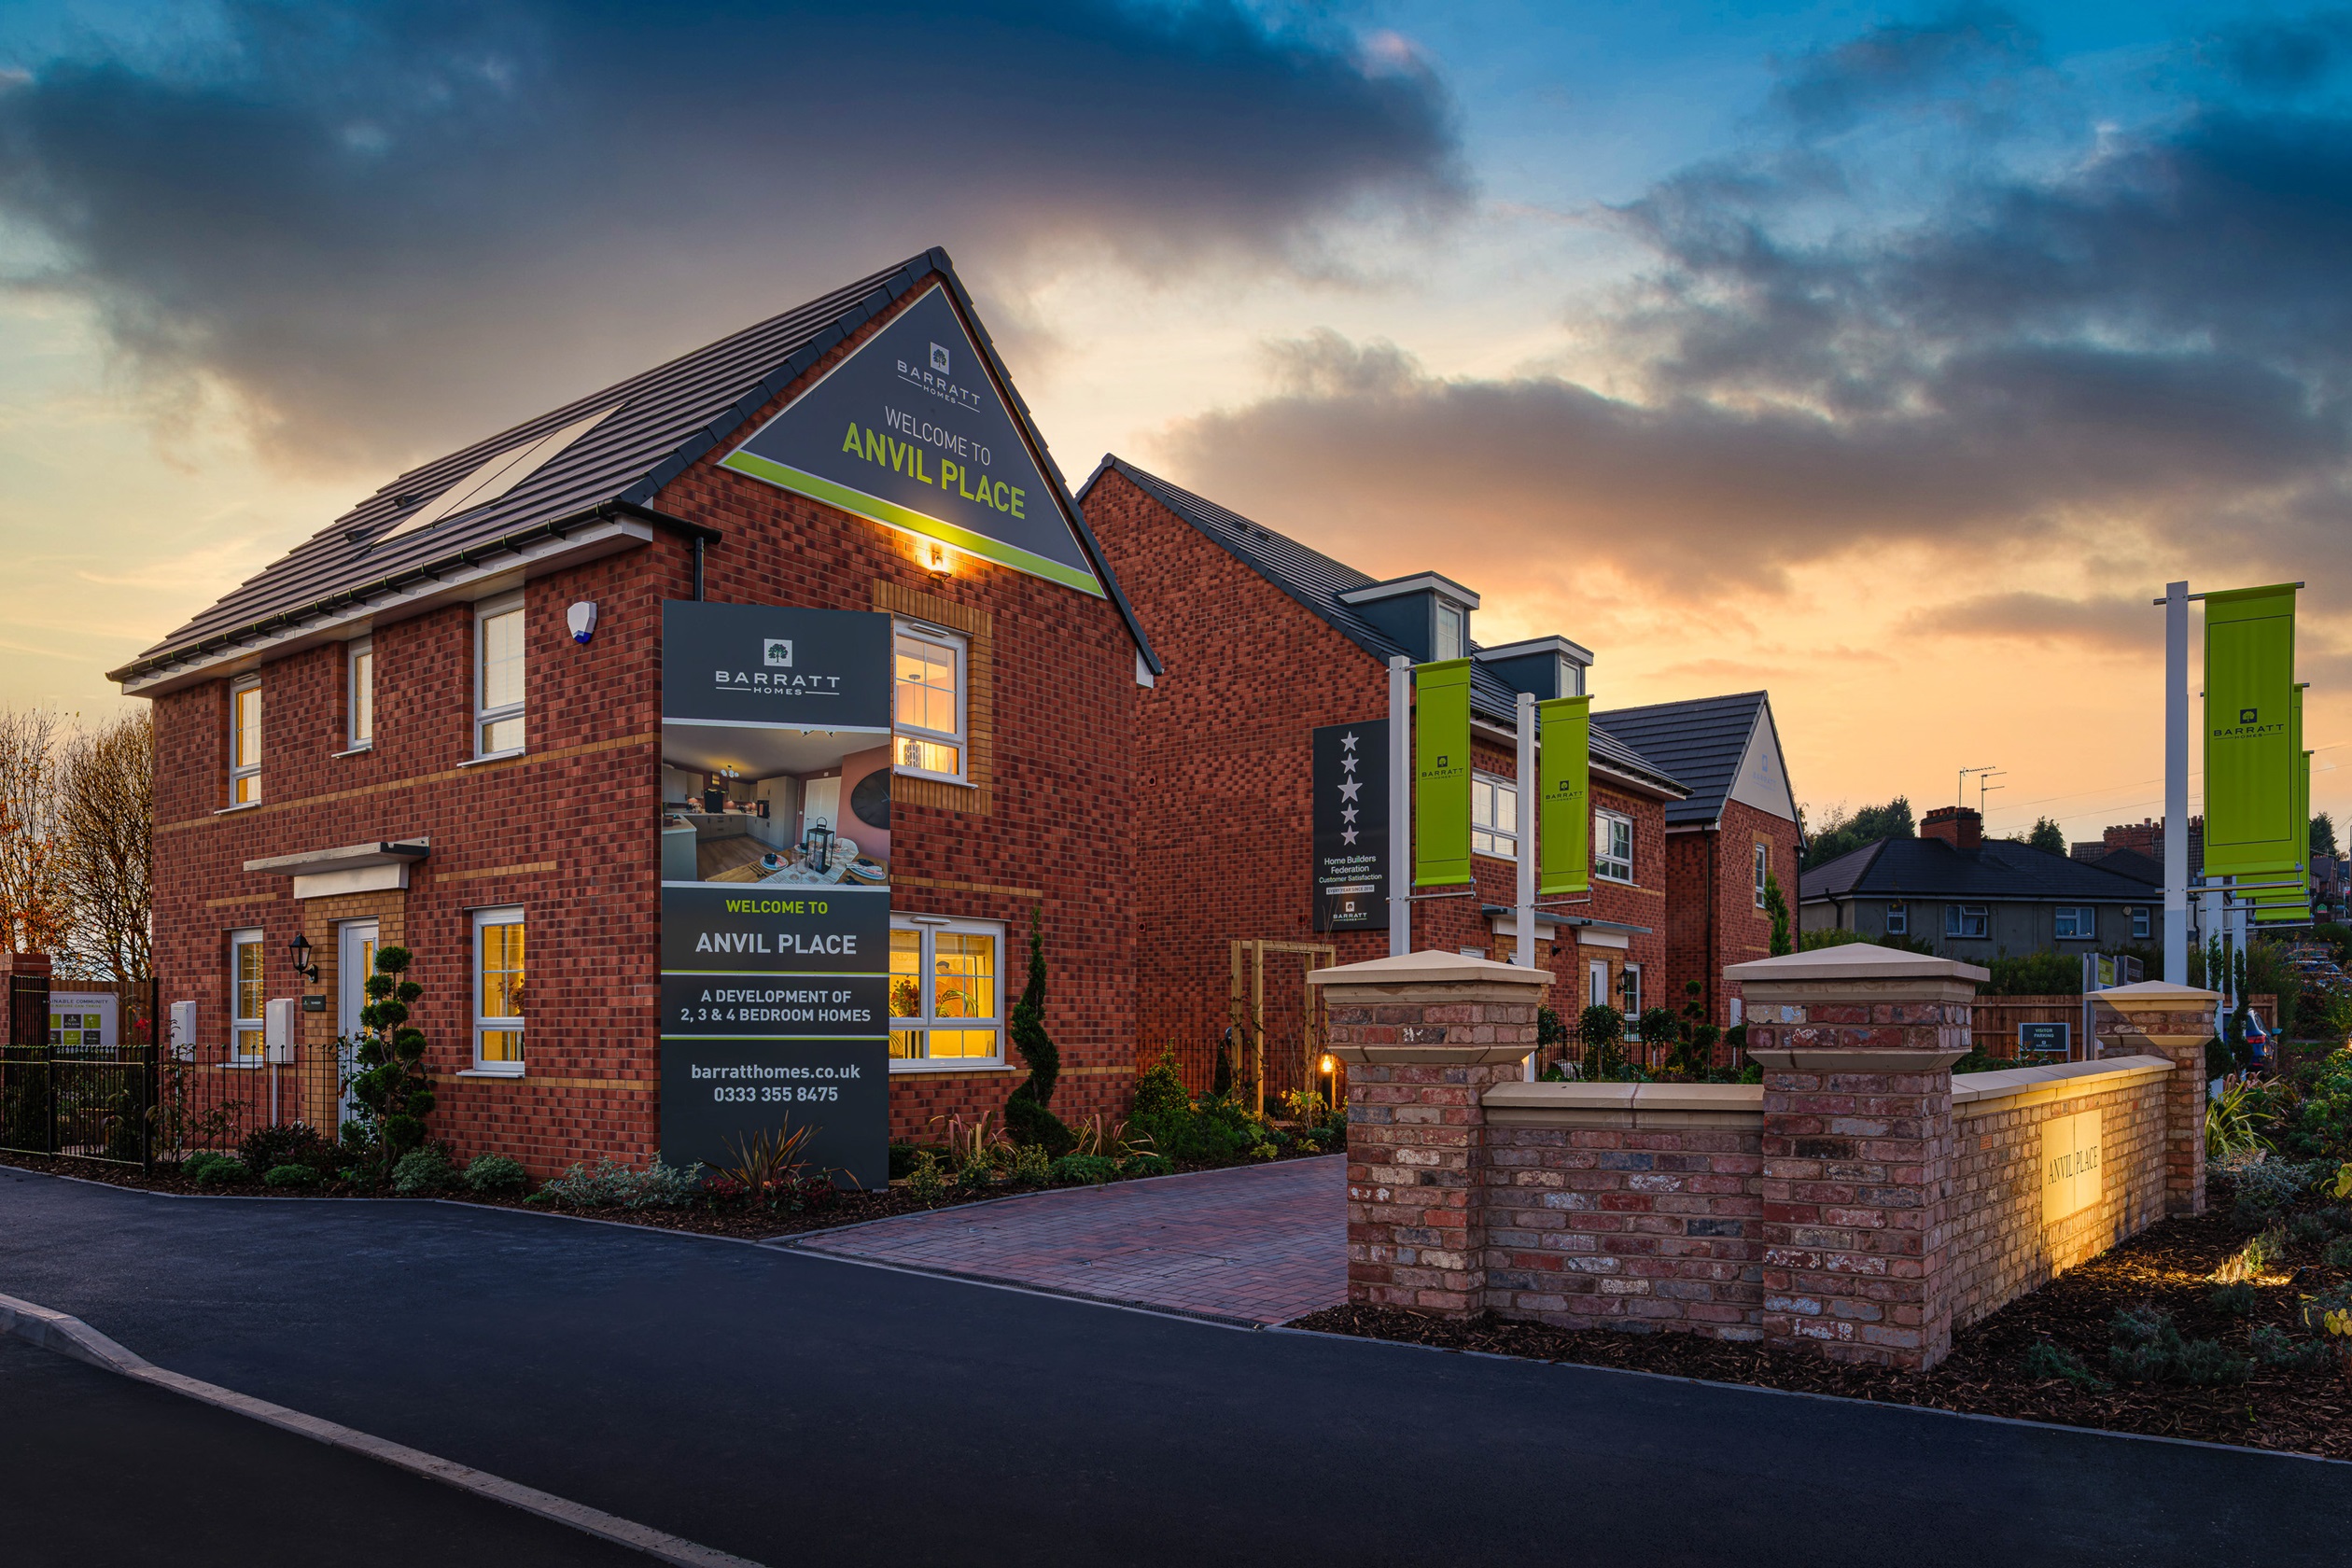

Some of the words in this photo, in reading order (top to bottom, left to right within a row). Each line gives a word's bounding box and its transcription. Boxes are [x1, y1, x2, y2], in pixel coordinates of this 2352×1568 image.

[897, 359, 981, 405] BARRATT
[923, 385, 957, 404] HOMES
[885, 405, 968, 457] WELCOME
[971, 441, 991, 466] TO
[842, 422, 932, 484] ANVIL
[941, 458, 1026, 520] PLACE
[715, 671, 840, 688] BARRATT
[753, 687, 803, 695] HOMES
[2214, 724, 2284, 735] BARRATT
[1421, 767, 1463, 777] BARRATT
[1545, 791, 1584, 800] BARRATT
[1347, 855, 1377, 863] Builders
[1331, 864, 1369, 874] Federation
[726, 900, 805, 914] WELCOME
[808, 902, 828, 915] TO
[695, 932, 771, 953] ANVIL
[778, 933, 857, 955] PLACE
[701, 989, 712, 1002] A
[716, 989, 828, 1003] DEVELOPMENT
[832, 990, 851, 1003] OF
[680, 1008, 694, 1023] 2,
[697, 1008, 707, 1021] 3
[710, 1008, 722, 1021] &
[726, 1008, 735, 1021] 4
[739, 1008, 814, 1022] BEDROOM
[819, 1009, 872, 1022] HOMES
[692, 1064, 861, 1079] barratthomes.co.uk
[714, 1086, 757, 1102] 0333
[761, 1086, 792, 1102] 355
[796, 1086, 838, 1102] 8475
[2048, 1154, 2074, 1185] ANVIL
[2076, 1145, 2098, 1175] PLACE
